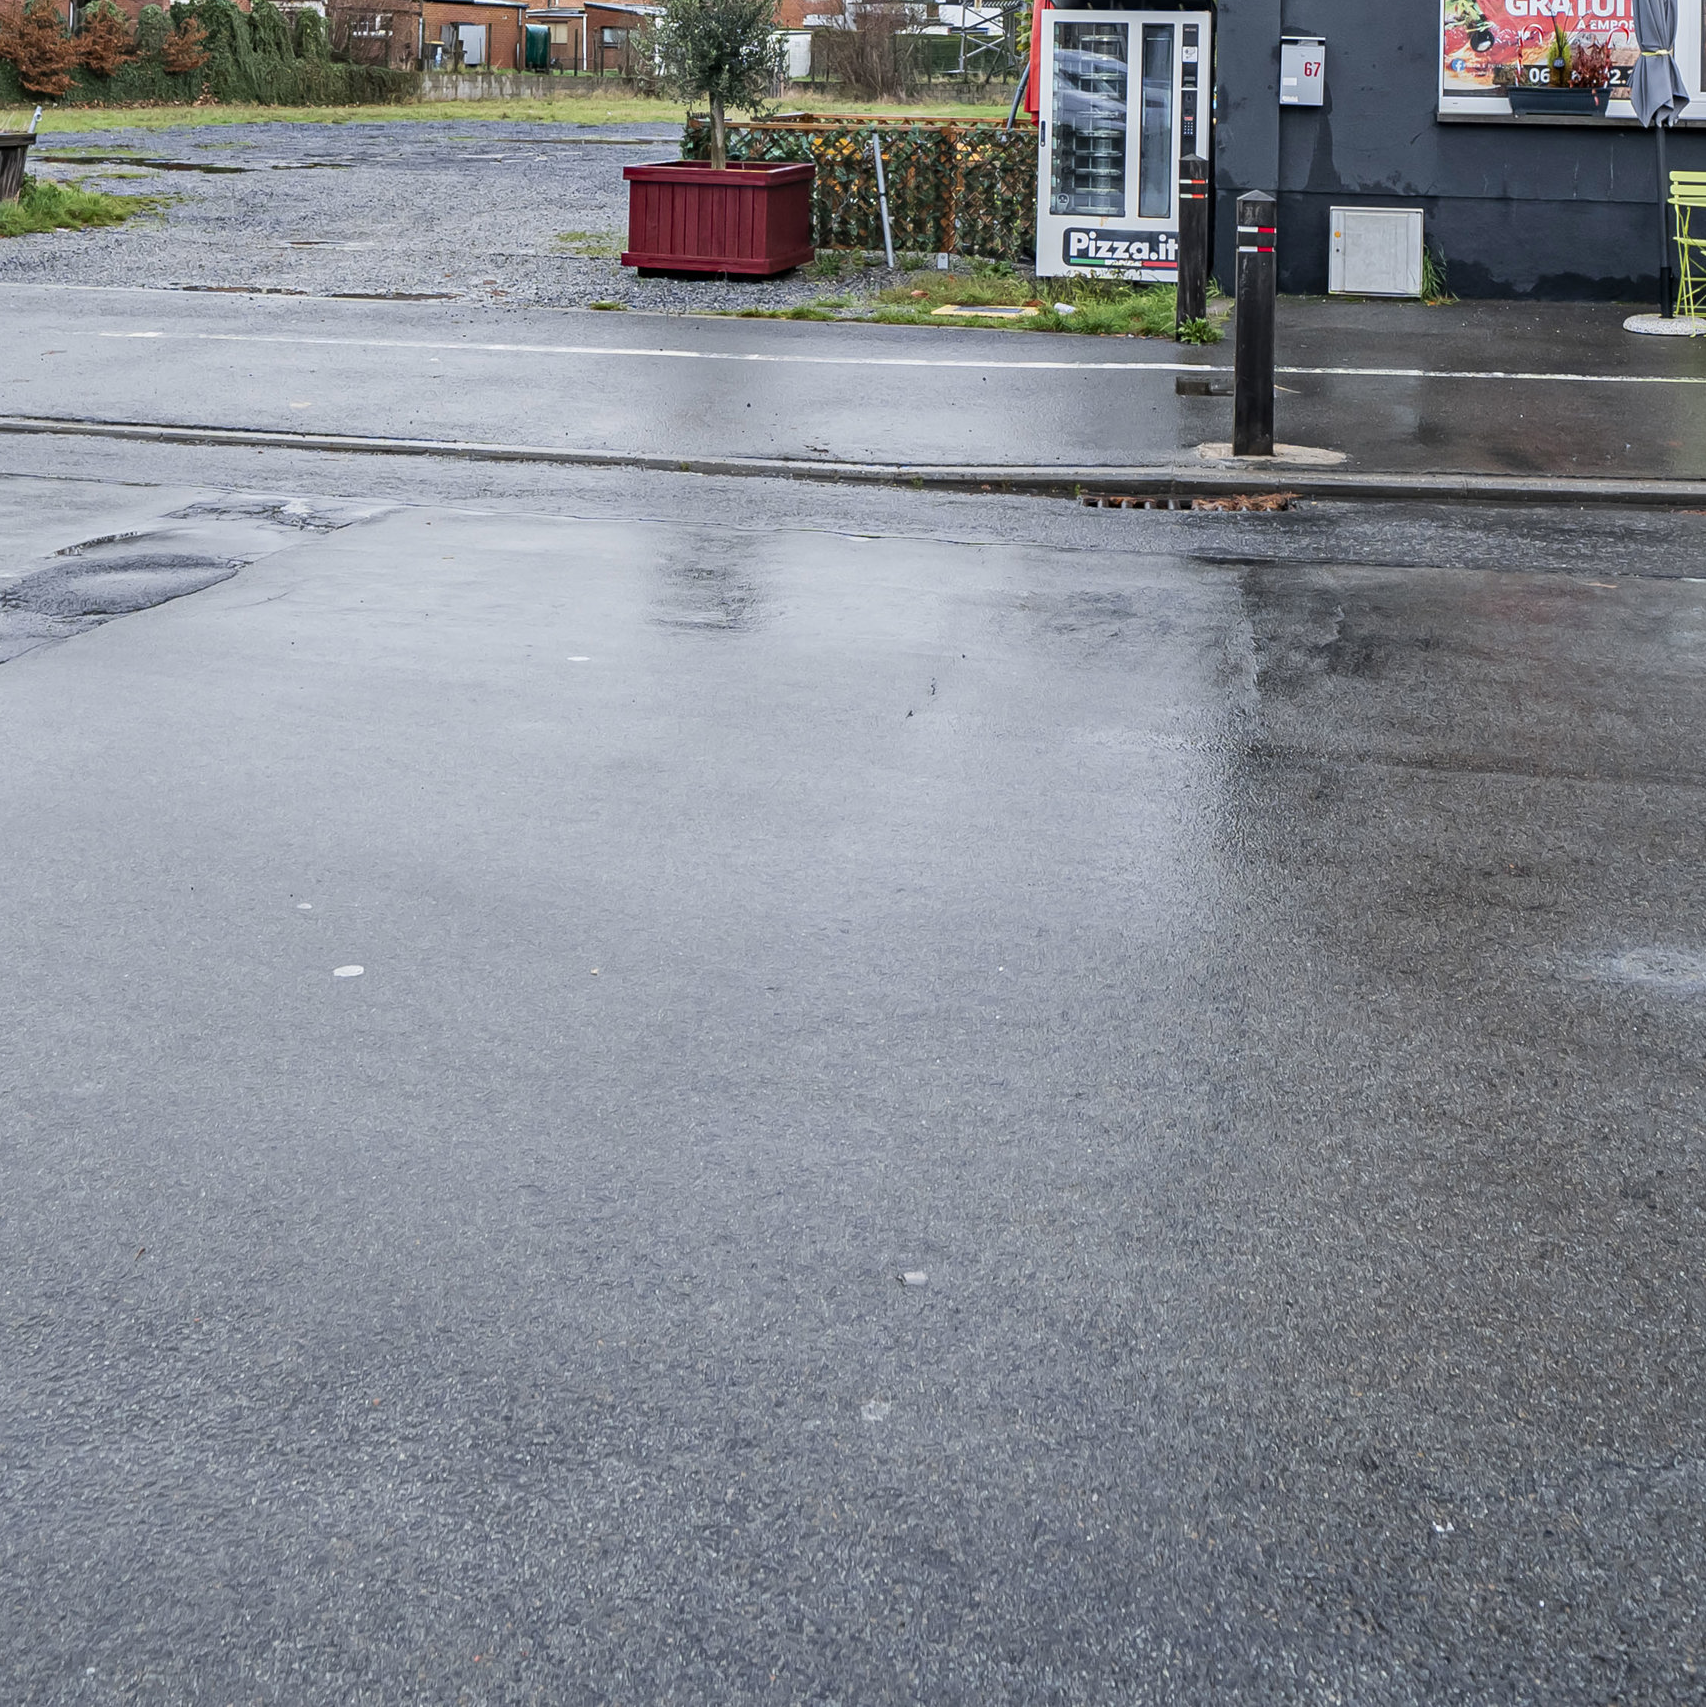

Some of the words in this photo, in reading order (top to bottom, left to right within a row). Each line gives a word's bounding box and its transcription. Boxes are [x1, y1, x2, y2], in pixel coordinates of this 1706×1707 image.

[1590, 19, 1635, 30] EMPOR
[1303, 62, 1321, 78] 67
[1069, 231, 1178, 261] Pizza.it
